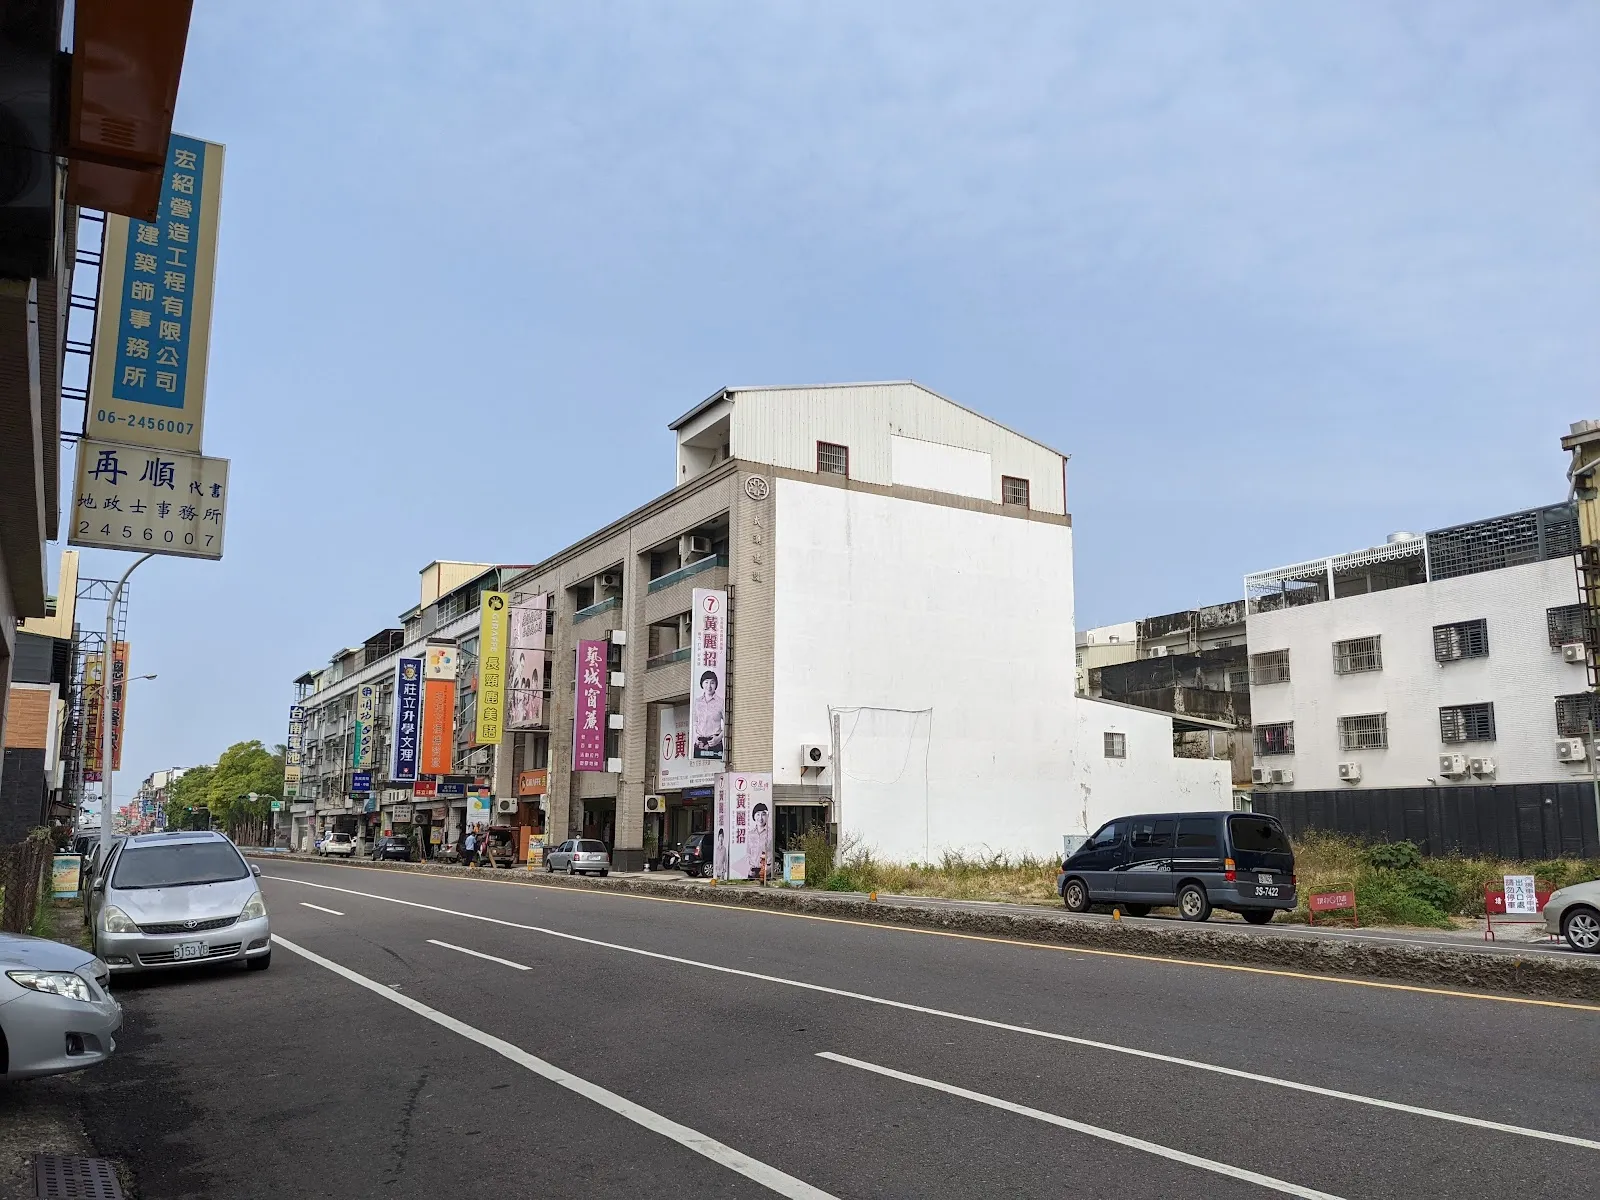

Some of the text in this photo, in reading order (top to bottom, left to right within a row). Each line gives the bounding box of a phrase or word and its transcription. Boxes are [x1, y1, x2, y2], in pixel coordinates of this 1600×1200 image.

[122, 201, 161, 388] 建築師事務所
[155, 149, 197, 393] 宏紹營造工程有限公司
[97, 409, 194, 435] 06-2456007
[88, 450, 223, 498] 再順 代書
[77, 493, 222, 525] 地政士事務所
[79, 520, 214, 547] 2456007
[703, 615, 717, 667] 黃麗招
[483, 656, 500, 738] 長頸鹿美語
[400, 683, 417, 762] 莊立升學文理
[675, 732, 687, 758] 黃
[736, 794, 746, 844] 黃麗招
[1505, 879, 1515, 909] 請勿停車
